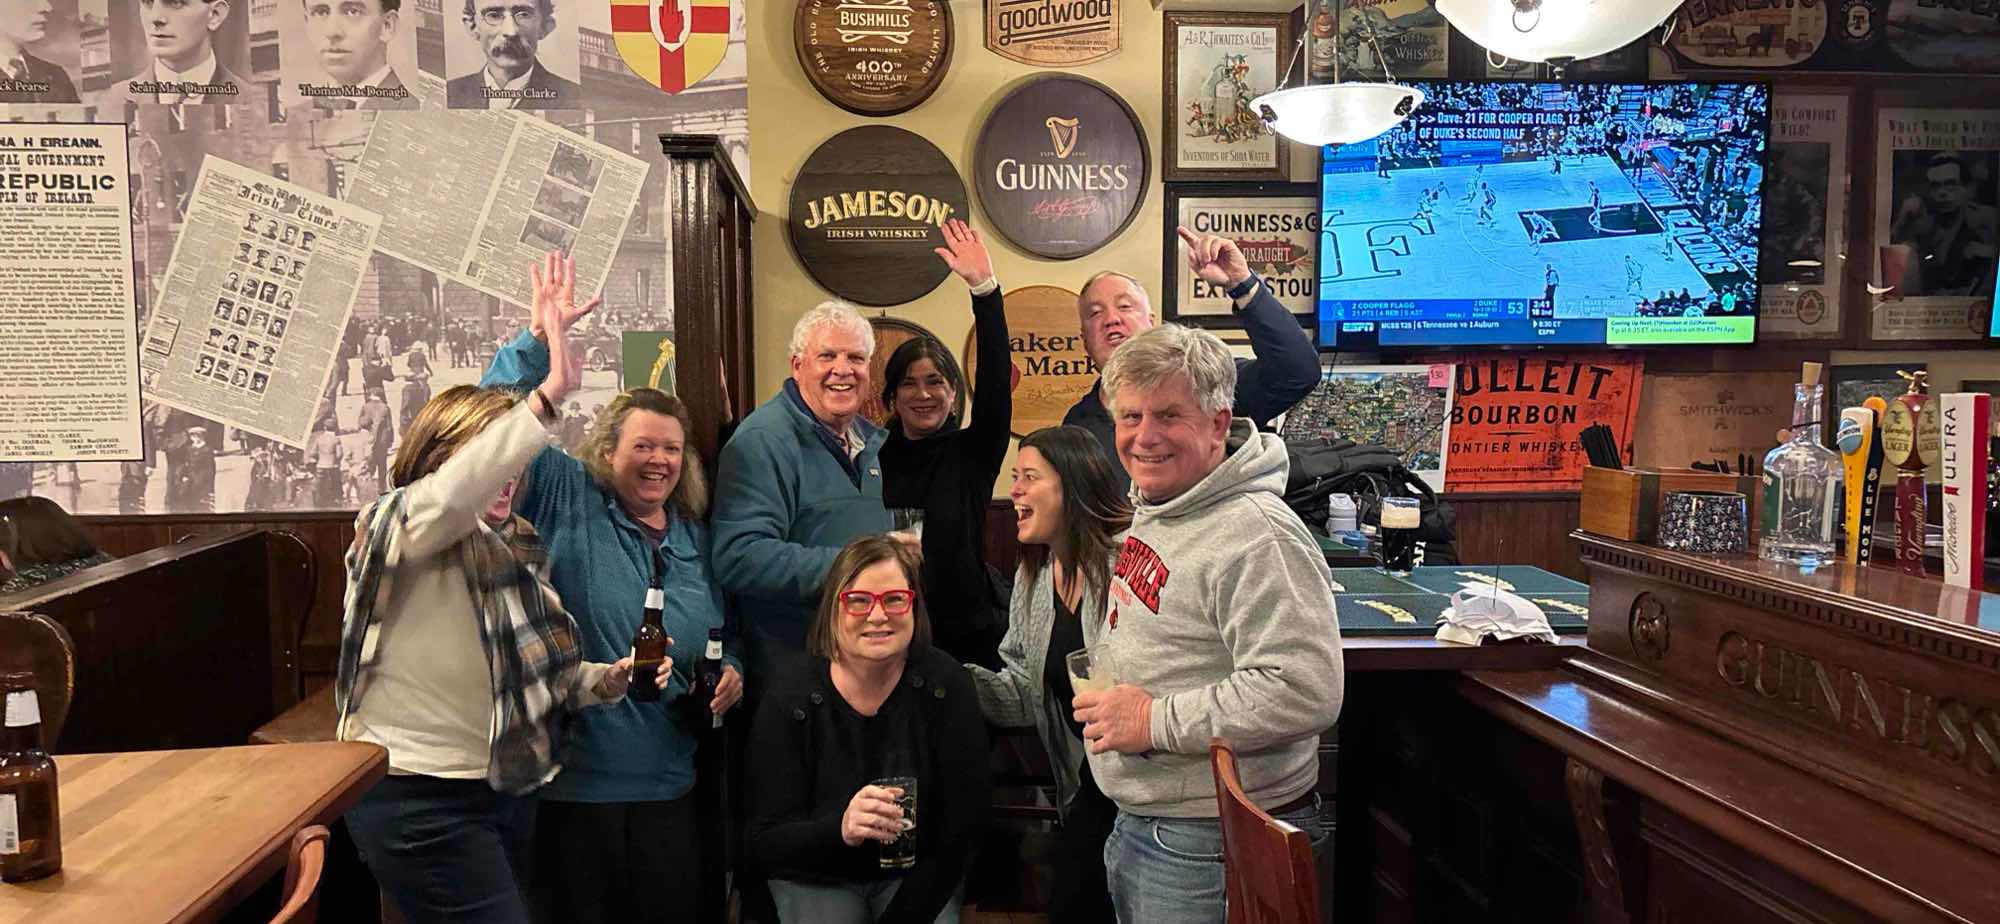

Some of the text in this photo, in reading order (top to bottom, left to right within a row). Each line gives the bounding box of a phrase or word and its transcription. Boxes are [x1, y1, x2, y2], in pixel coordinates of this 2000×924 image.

[840, 11, 910, 27] BUSHMILLS
[998, 0, 1112, 46] goodwood
[810, 22, 818, 46] OLD
[922, 28, 940, 74] LIMITED
[814, 52, 829, 73] THE
[845, 73, 908, 82] ANNIVERSARY
[15, 80, 49, 92] Pearse
[159, 82, 183, 94] Mac
[184, 82, 240, 95] Diarmada
[299, 84, 409, 98] Thomas MacDonagh
[481, 87, 557, 99] Thomas Clarke
[1437, 111, 1463, 124] Dave:
[1464, 112, 1476, 124] 21
[1478, 112, 1497, 124] FOR
[1498, 112, 1534, 125] COOPER
[1568, 113, 1580, 125] 12
[1791, 108, 1838, 121] COMFORT
[1419, 127, 1526, 140] OF DUKE'S SECOND HALF
[23, 137, 33, 147] H
[40, 137, 102, 148] EIREANN.
[27, 154, 105, 167] GOVERNMENT
[1182, 150, 1219, 162] INVENTORS
[995, 159, 1129, 191] GUINNESS
[25, 192, 38, 203] OF
[45, 192, 95, 204] IRELAND.
[237, 184, 280, 210] Irish
[297, 206, 338, 230] Times
[804, 190, 950, 228] JAMESON
[827, 229, 928, 238] IRISH WHISKEY
[1243, 247, 1292, 262] DRAUGHT
[1507, 302, 1524, 314] 53
[1343, 322, 1375, 332] ESPN
[1423, 321, 1458, 329] Tennessee
[1023, 355, 1098, 377] Mark
[1451, 404, 1578, 425] BOURBON
[1679, 404, 1776, 417] SMITHWICK'S
[1944, 406, 1957, 480] ULTRA
[1860, 467, 1879, 567] BLUE MOON
[1716, 630, 2000, 777] GUINNESS
